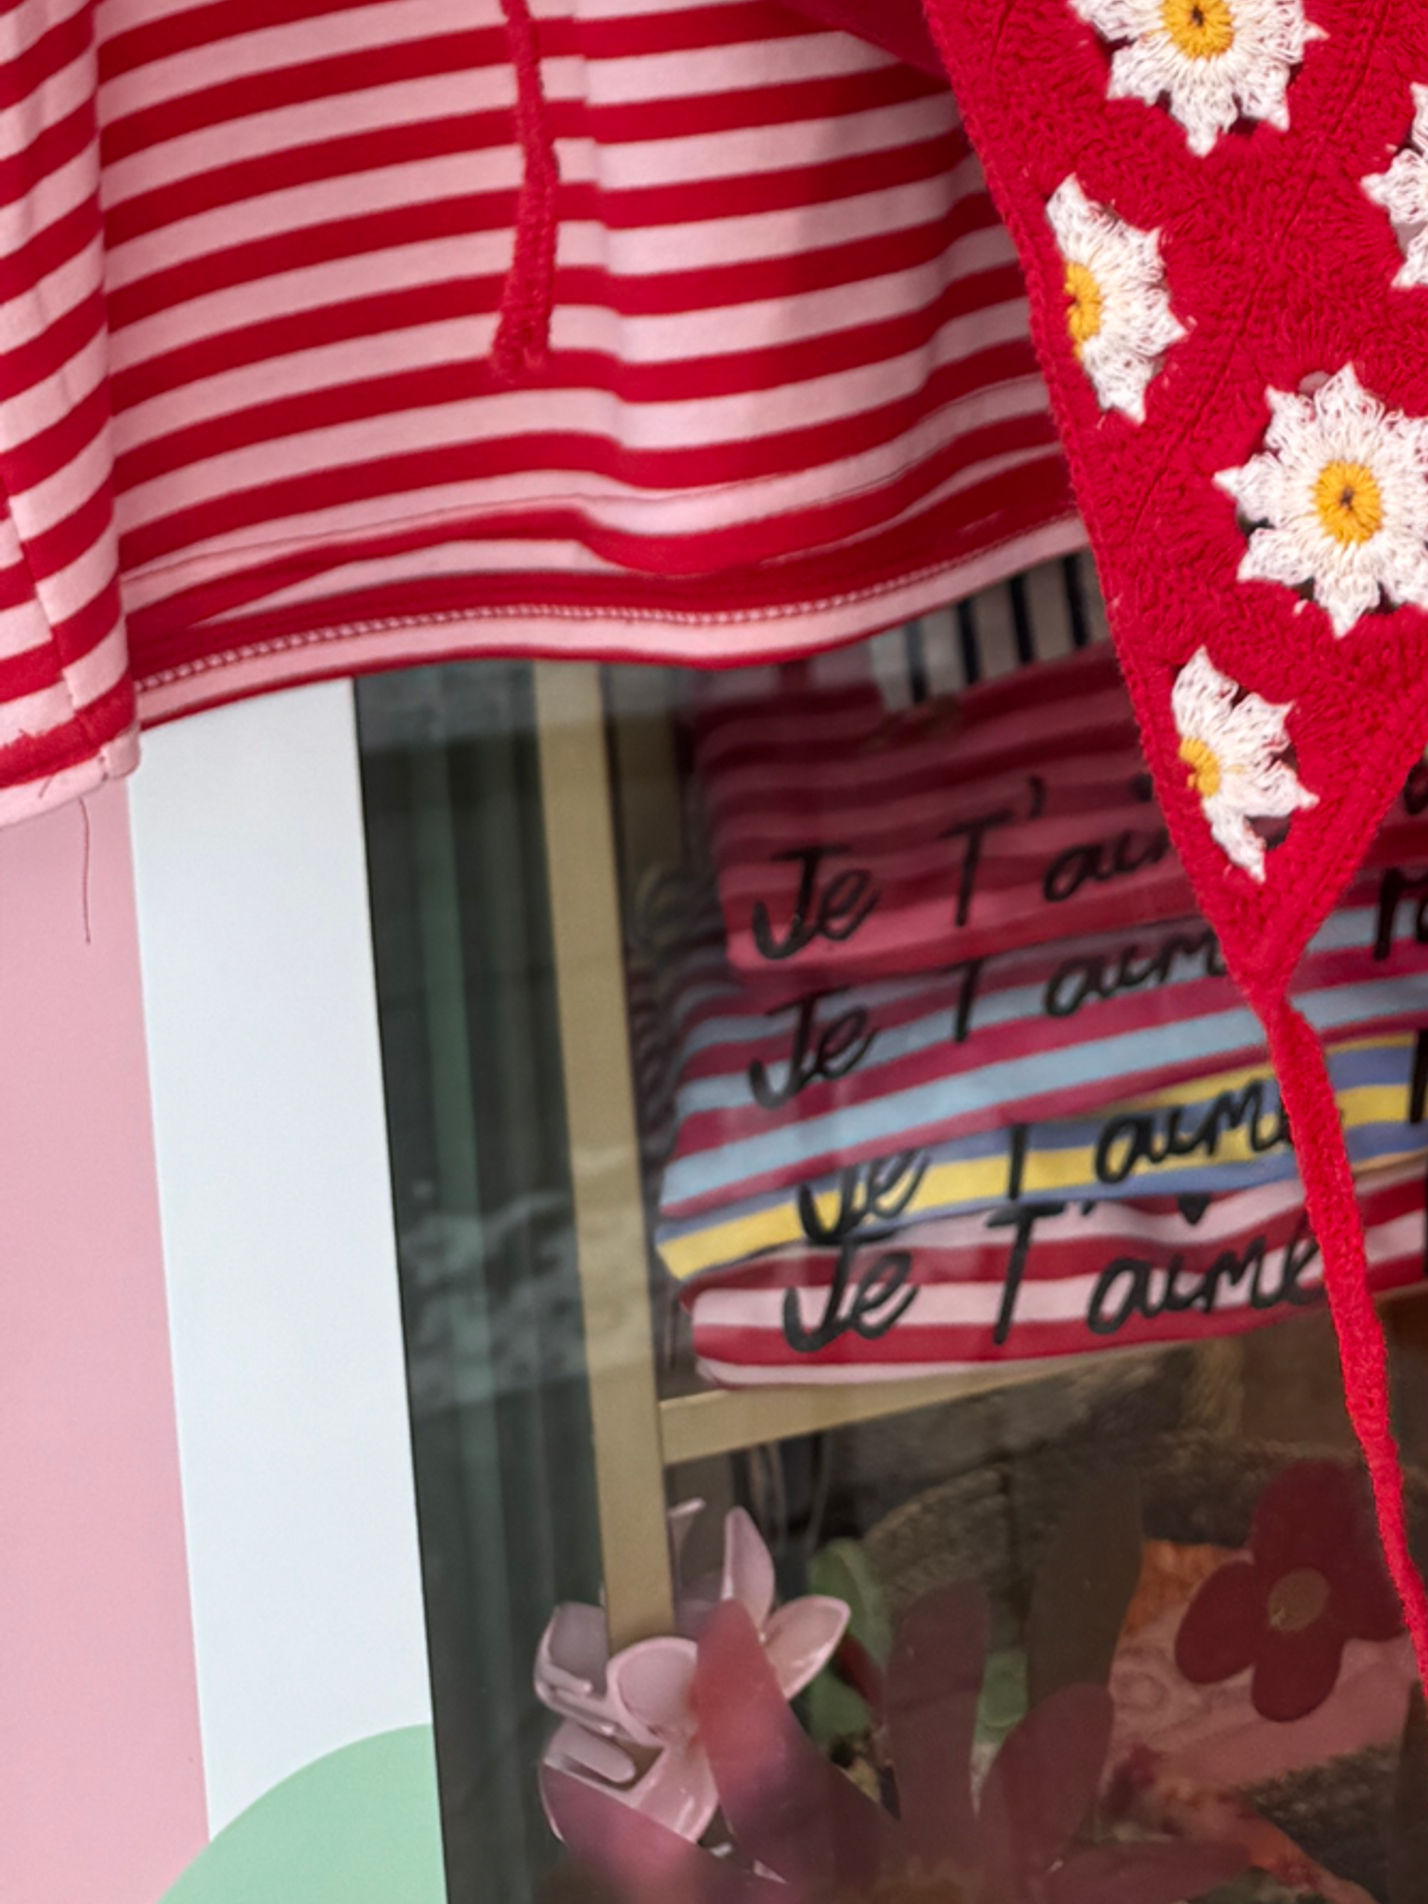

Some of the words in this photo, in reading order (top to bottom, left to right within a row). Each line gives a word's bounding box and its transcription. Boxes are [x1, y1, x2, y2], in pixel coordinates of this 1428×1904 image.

[752, 845, 880, 959] Je
[748, 986, 880, 1110] Je
[782, 1229, 920, 1354] Je
